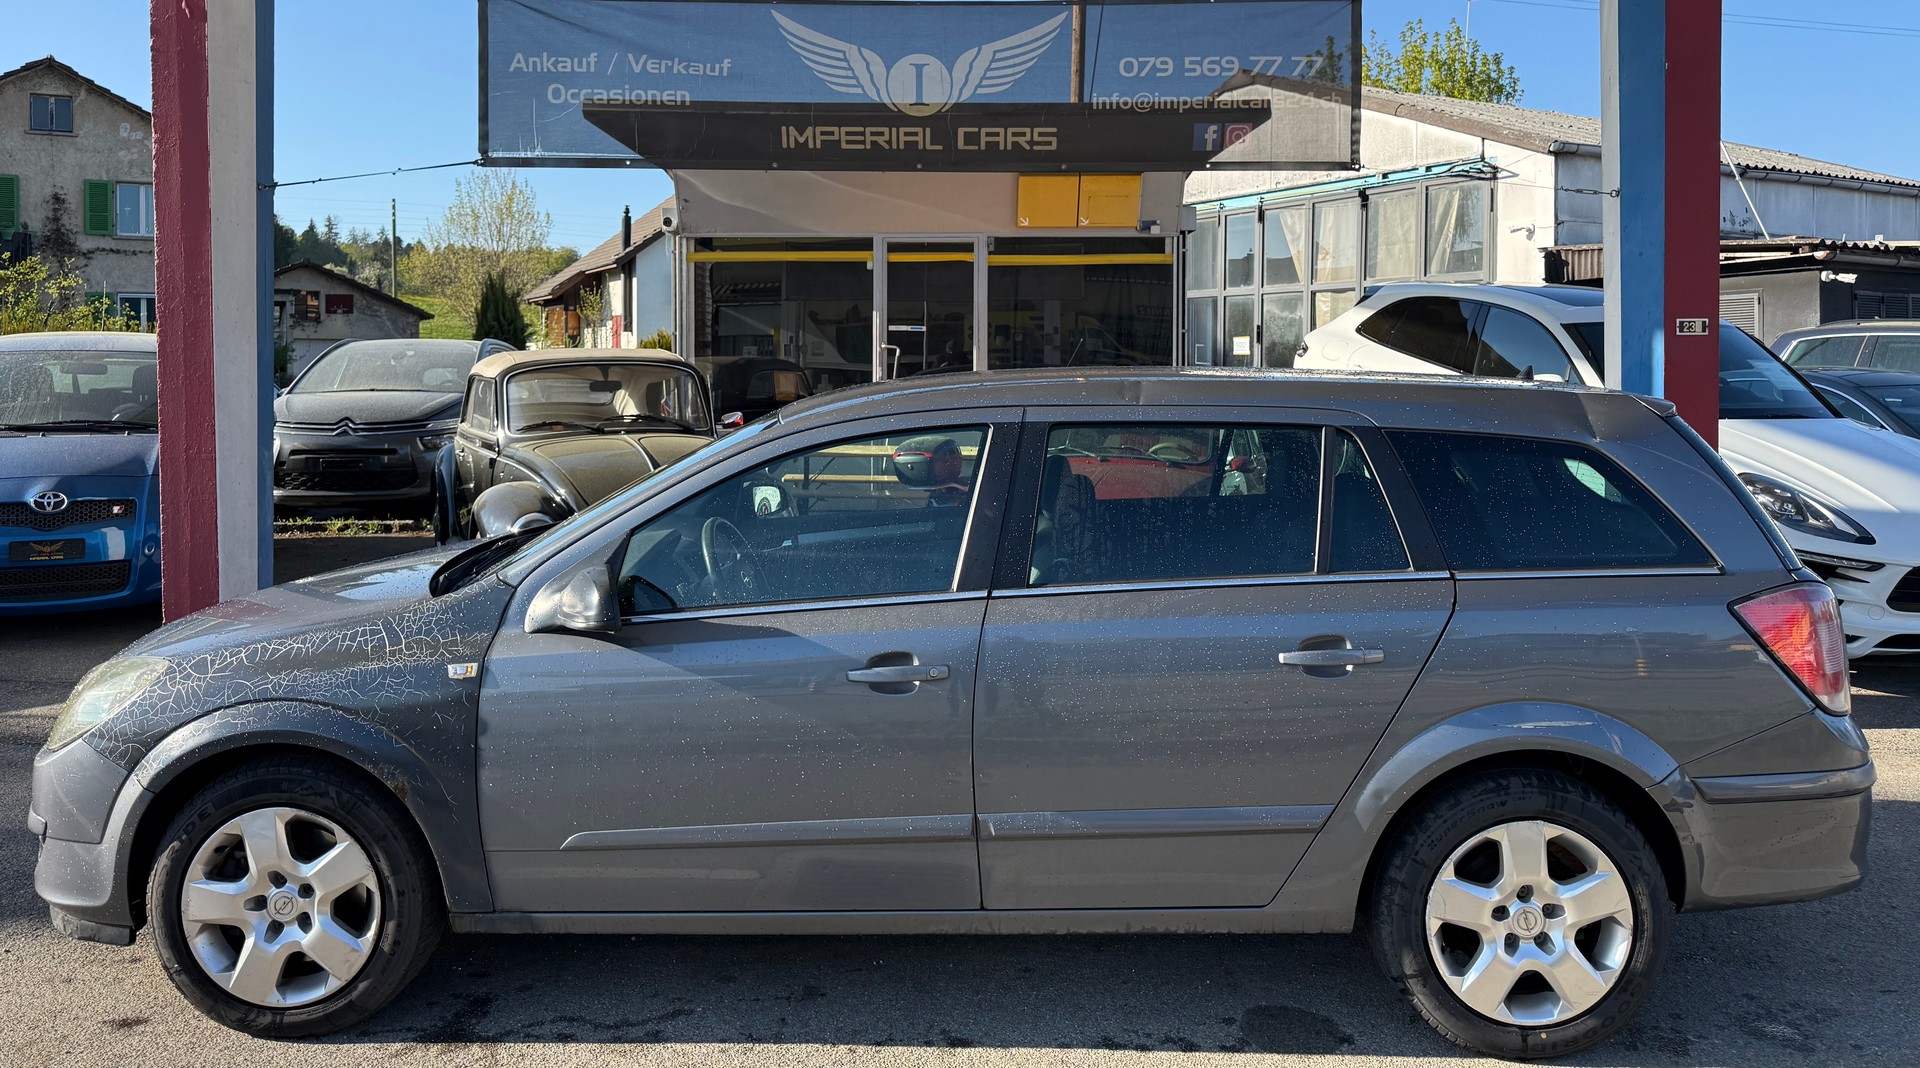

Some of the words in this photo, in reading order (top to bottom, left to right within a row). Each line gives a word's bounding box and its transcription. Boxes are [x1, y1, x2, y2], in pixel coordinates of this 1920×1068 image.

[509, 52, 599, 74] Ankauf
[607, 53, 618, 75] /
[628, 53, 732, 77] Verkauf
[1119, 56, 1174, 78] 079
[1184, 56, 1240, 78] 569
[1249, 56, 1283, 77] 77
[1291, 56, 1324, 77] 77
[547, 83, 691, 106] Occasionen
[781, 126, 943, 150] IMPERIAL
[957, 127, 1058, 151] CARS
[1683, 321, 1696, 332] 23
